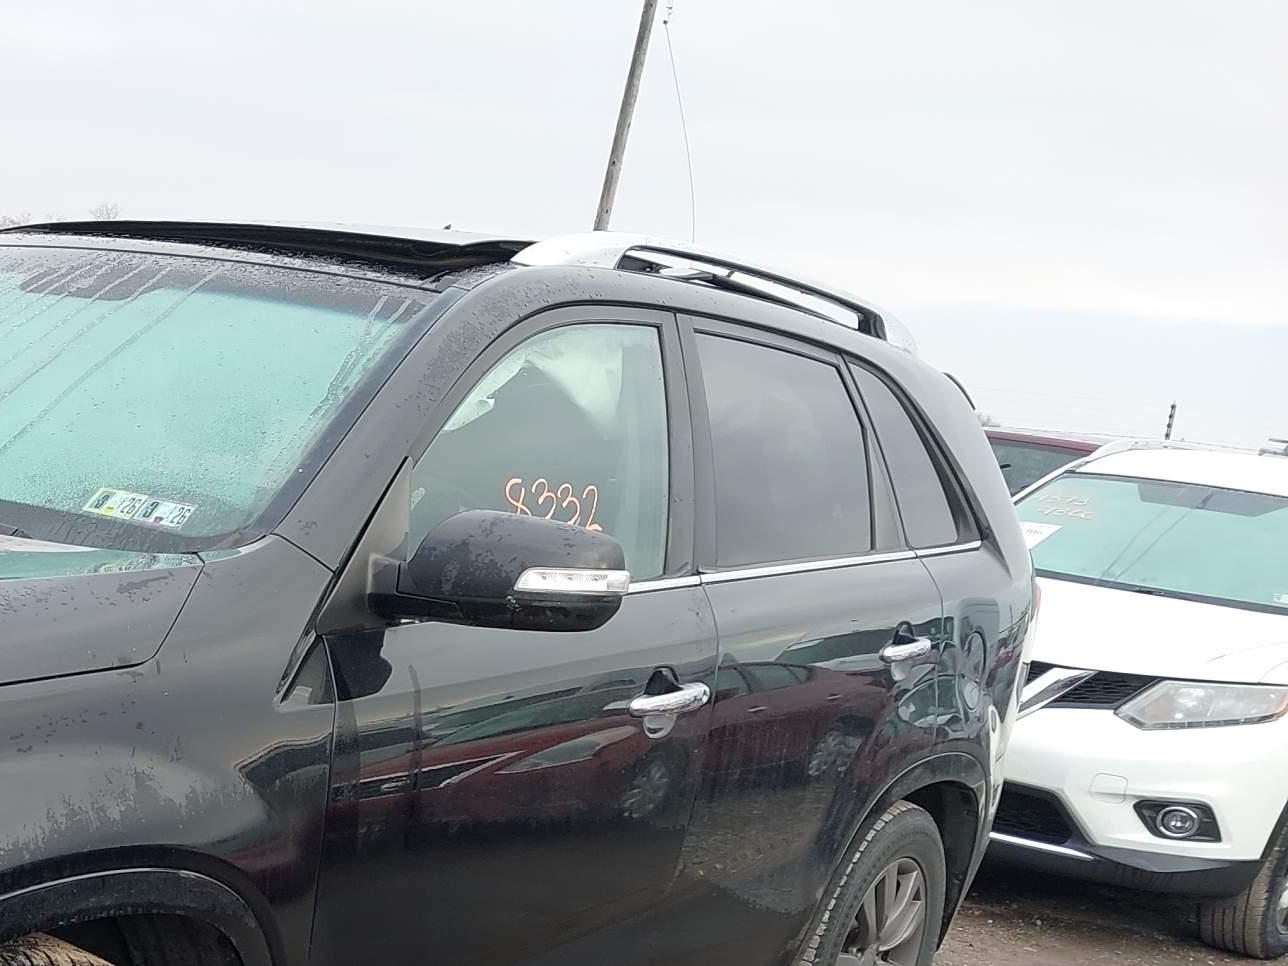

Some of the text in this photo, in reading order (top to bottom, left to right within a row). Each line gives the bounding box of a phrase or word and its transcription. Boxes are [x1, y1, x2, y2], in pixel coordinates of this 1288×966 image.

[94, 494, 143, 515] 3 26
[142, 501, 192, 525] 3 26
[505, 478, 603, 531] 8332
